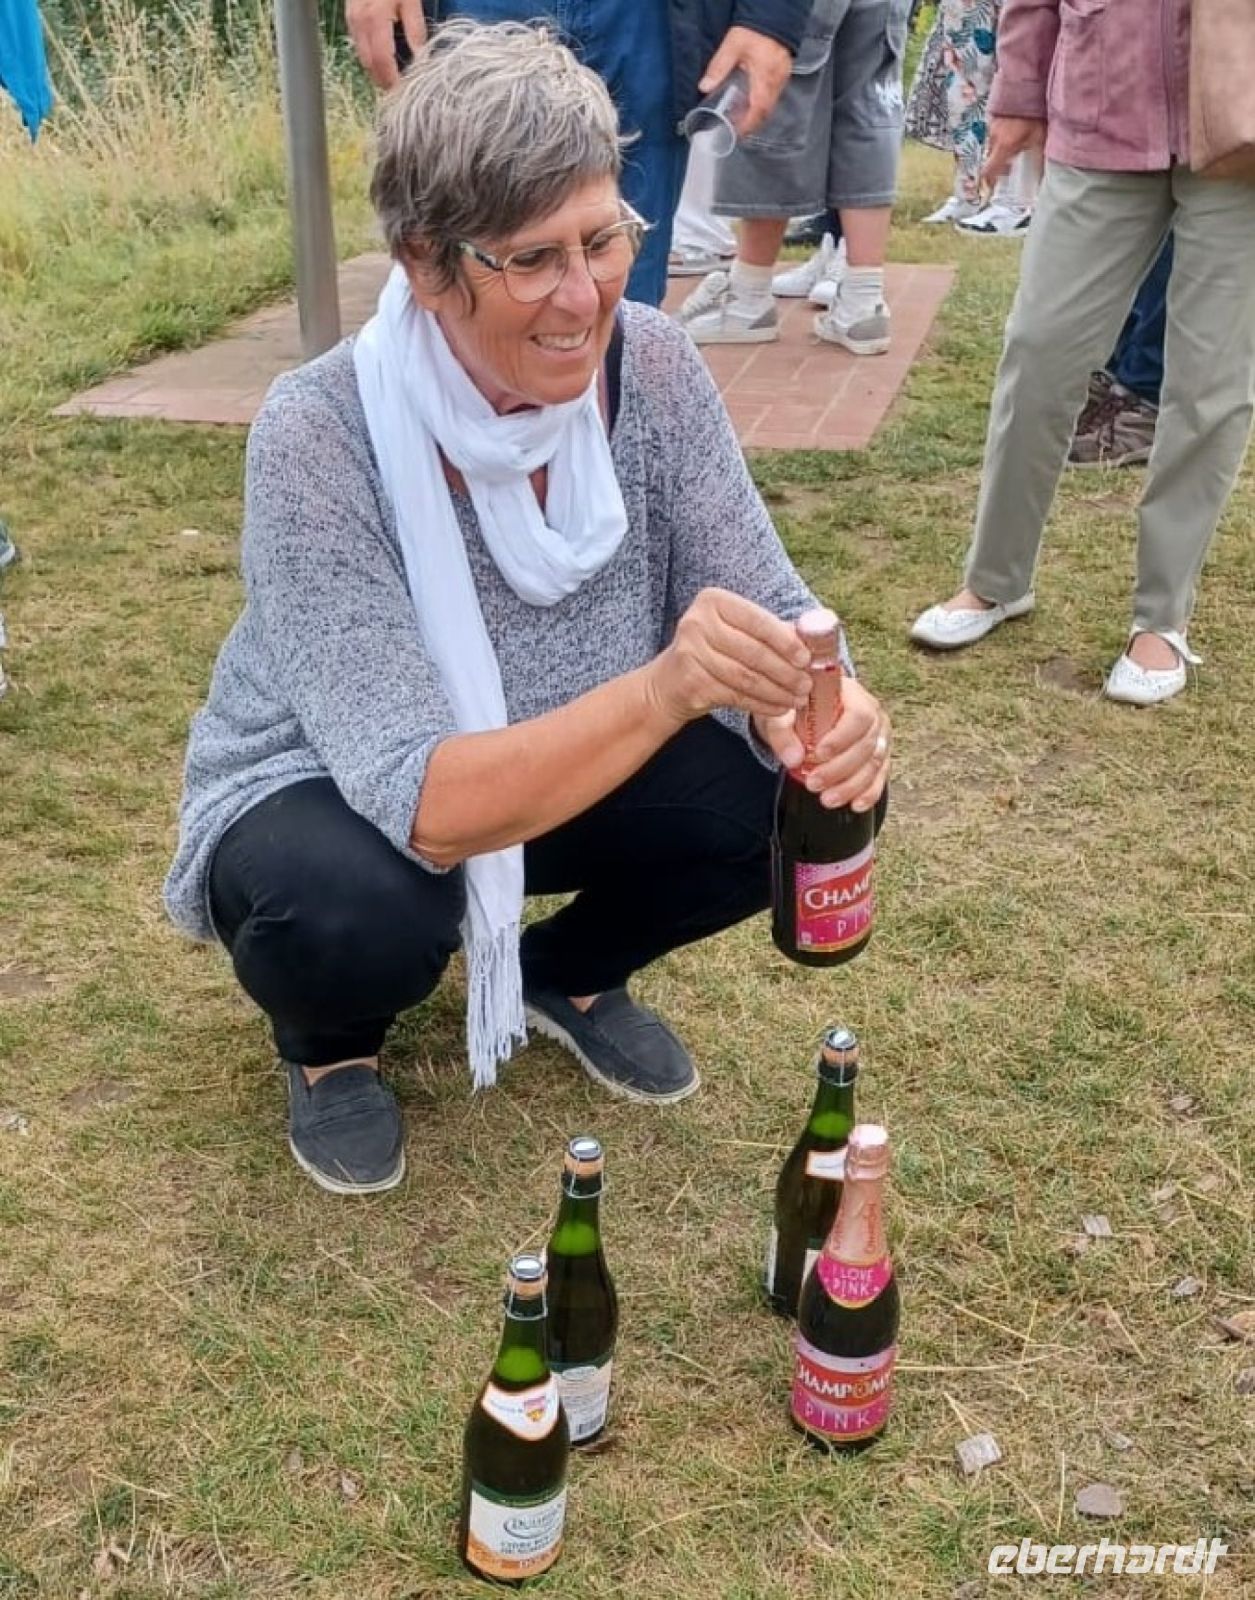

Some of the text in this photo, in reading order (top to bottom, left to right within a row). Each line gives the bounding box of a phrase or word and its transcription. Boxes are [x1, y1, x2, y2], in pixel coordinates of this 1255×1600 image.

[841, 1267, 874, 1281] LOVE
[832, 1277, 870, 1298] PINK
[804, 1401, 871, 1430] PINK
